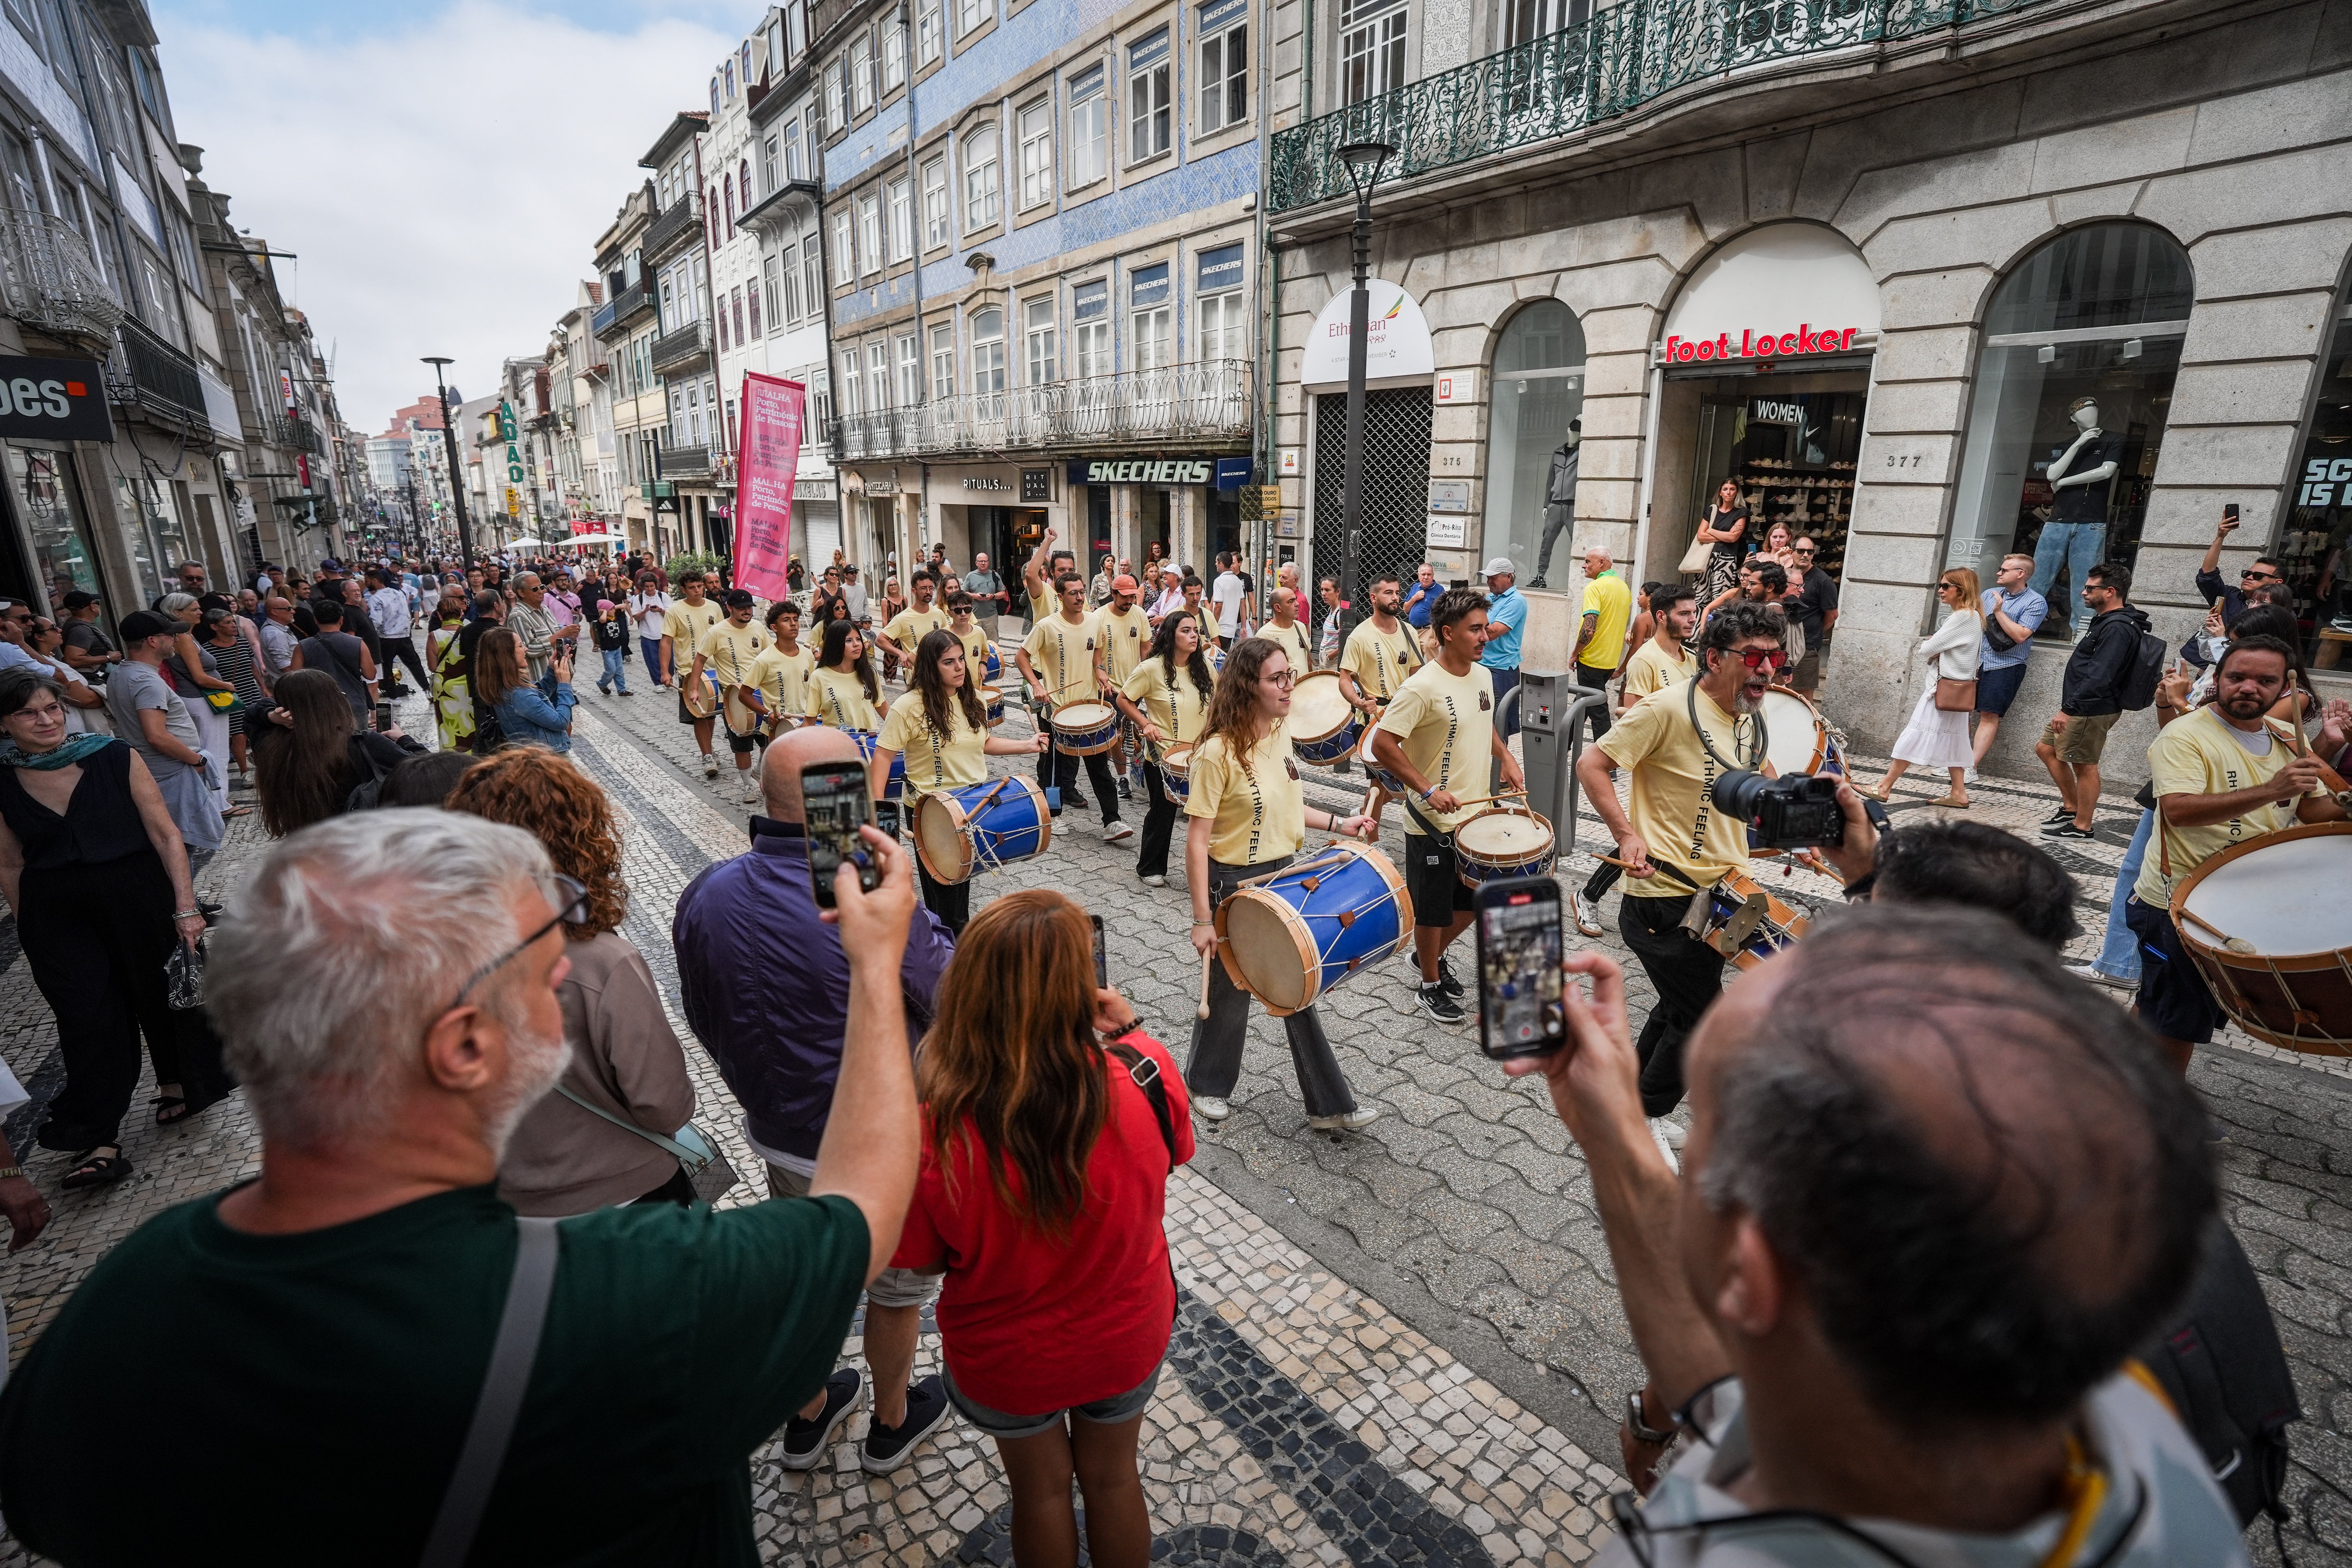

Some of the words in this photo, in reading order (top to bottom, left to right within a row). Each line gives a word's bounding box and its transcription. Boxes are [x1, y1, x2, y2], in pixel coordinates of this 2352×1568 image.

[1203, 0, 1245, 24] SKECHERS
[1132, 35, 1168, 62] SKECHERS
[1073, 72, 1104, 94] SKECHERS
[1201, 259, 1242, 275] SKECHERS
[1134, 277, 1168, 292] SKECHERS
[1077, 293, 1106, 305] SKECHERS
[1329, 319, 1386, 337] Ethiian
[1666, 333, 1730, 363] Foot
[1741, 323, 1859, 357] Locker
[756, 397, 779, 410] Porto,
[757, 388, 791, 403] MALHA
[755, 405, 799, 421] Património
[1757, 400, 1804, 423] WOMEN
[767, 416, 797, 429] Pessoas
[754, 433, 787, 446] MALHA
[754, 441, 777, 454] Porto,
[753, 450, 795, 465] Património
[753, 457, 764, 466] de
[765, 460, 793, 472] Pessoas
[1443, 457, 1461, 466] 375
[1887, 456, 1921, 467] 377
[1087, 461, 1213, 483] SKECHERS
[752, 477, 786, 490] MALHA
[752, 484, 775, 496] Porto,
[794, 482, 826, 498] RUXELAS
[963, 479, 1011, 490] RITUALS...
[752, 492, 788, 508] Património
[2298, 484, 2335, 506] IS
[751, 499, 762, 508] de
[763, 501, 786, 515] Pessoas
[751, 525, 771, 537] Porto,
[750, 533, 784, 549] Património
[761, 543, 782, 556] Pessoas
[748, 563, 783, 577] malha.porto.pt
[745, 582, 761, 591] Porto.
[686, 614, 695, 639] RHYTHMIC
[727, 637, 737, 666] RHYTHMIC
[1375, 643, 1384, 678] RHYTHMIC
[828, 687, 844, 723] RHYTHMIC
[1445, 696, 1457, 748] RHYTHMIC
[934, 756, 943, 788] FEELING
[1439, 751, 1451, 791] FEELING
[1690, 806, 1708, 860] FEELING
[1249, 830, 1260, 863] FEELI
